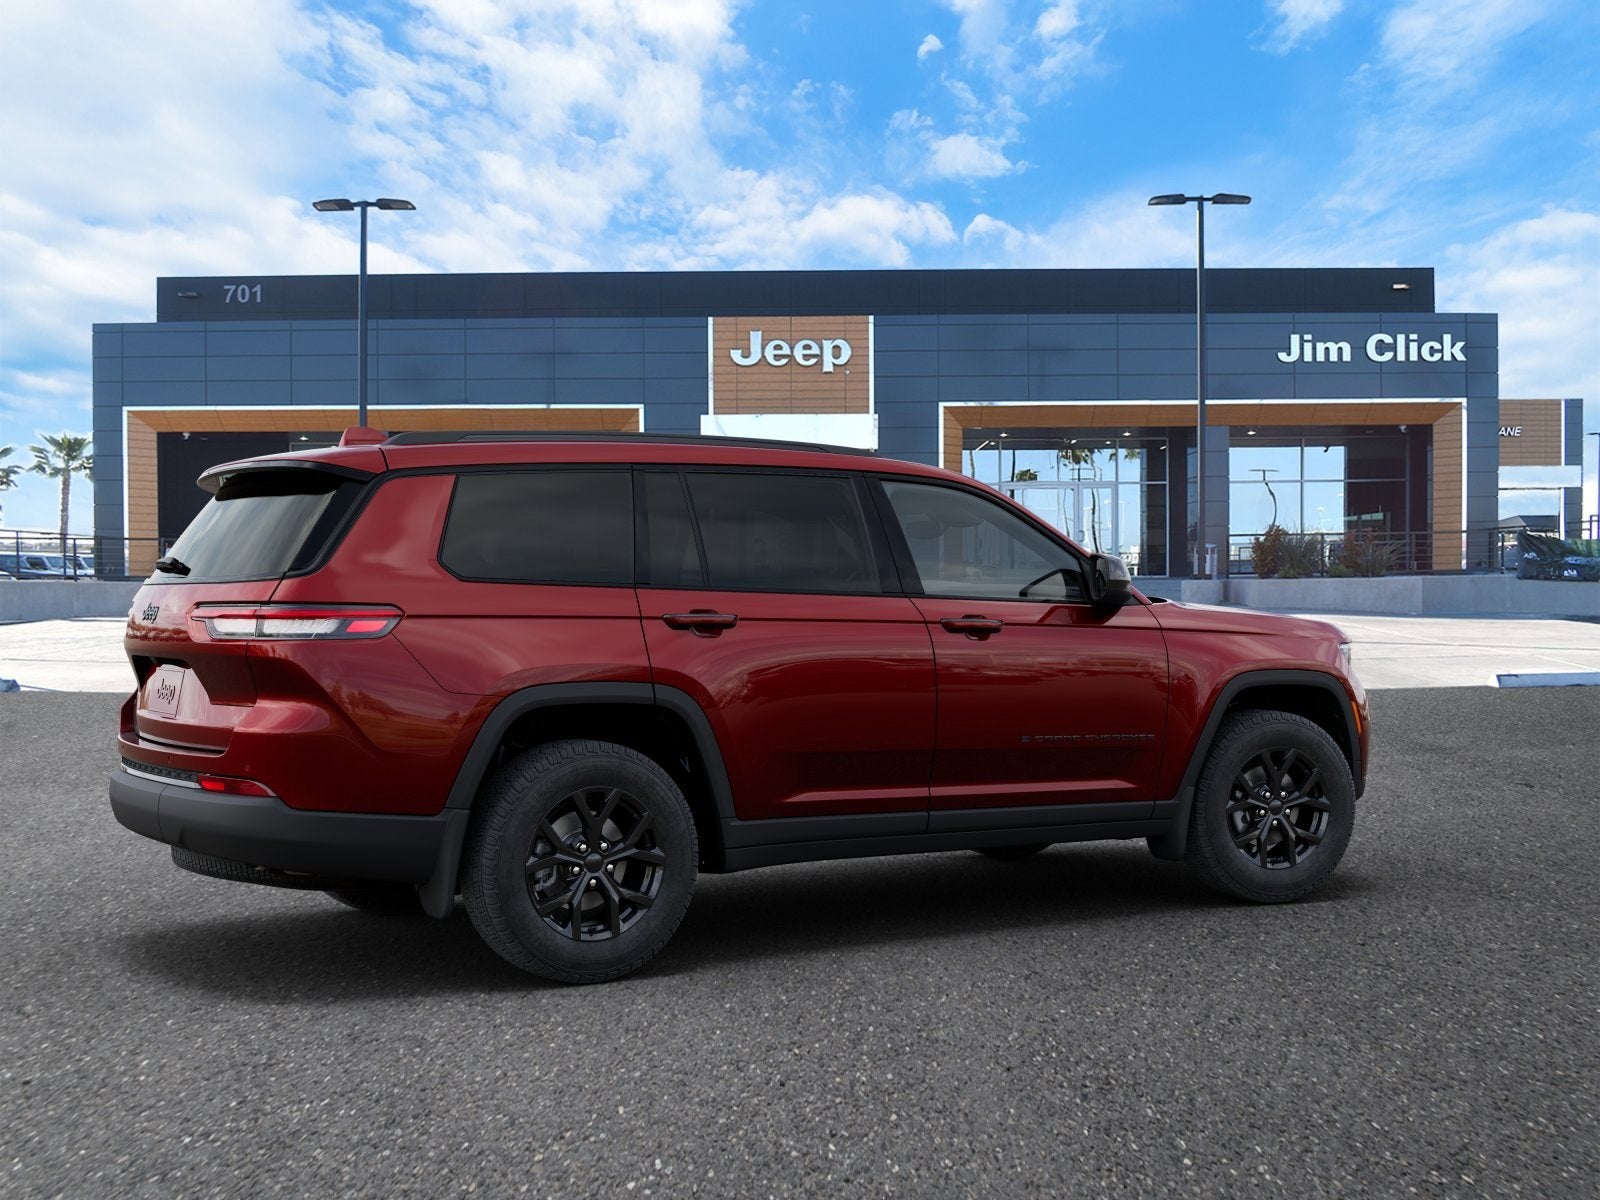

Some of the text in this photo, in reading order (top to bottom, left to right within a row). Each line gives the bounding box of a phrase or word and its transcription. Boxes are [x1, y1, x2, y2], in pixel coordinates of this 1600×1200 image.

[223, 284, 262, 303] 701
[729, 330, 852, 373] Jeep
[1277, 333, 1467, 363] Jim Click
[142, 602, 160, 624] Jeep
[157, 678, 176, 704] Jeep
